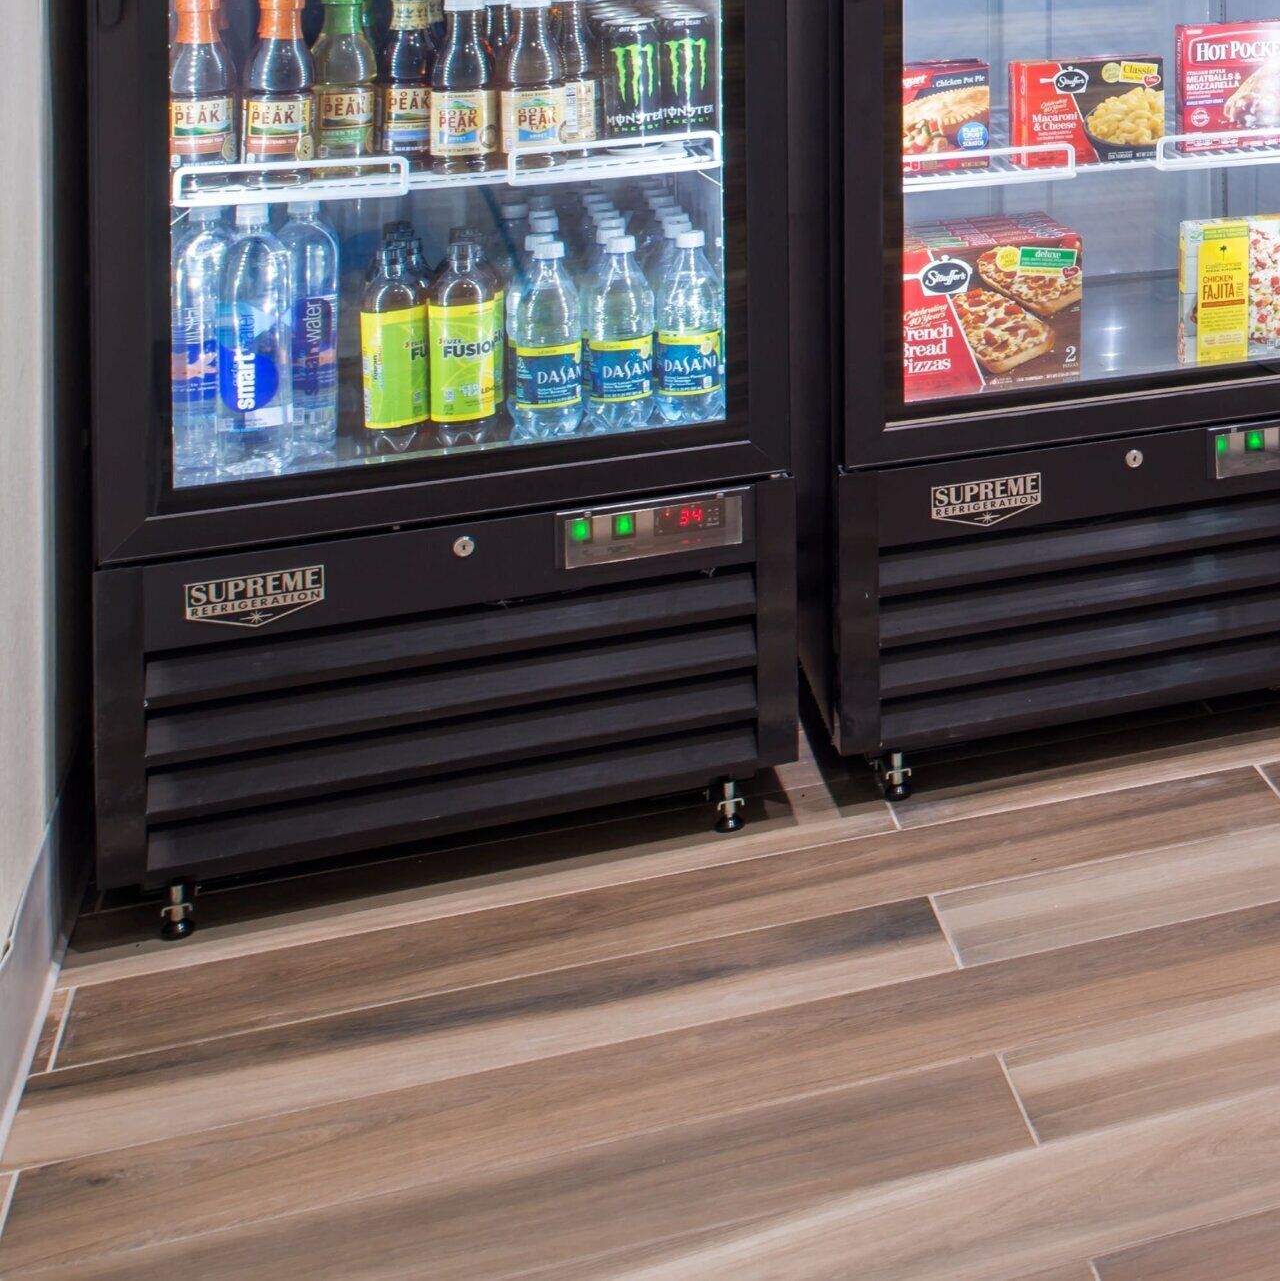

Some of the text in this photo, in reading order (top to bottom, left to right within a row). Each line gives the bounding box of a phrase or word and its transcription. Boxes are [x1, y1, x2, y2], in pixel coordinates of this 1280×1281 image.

[1196, 42, 1228, 62] HOT
[1123, 64, 1155, 75] Classic
[936, 79, 962, 88] Chicken
[1186, 73, 1233, 83] MEATBALLS
[1186, 80, 1239, 91] MOZZARELLA
[174, 103, 220, 111] GOLD
[324, 102, 365, 116] PEAK
[388, 96, 431, 110] PEAK
[174, 110, 220, 124] PEAK
[252, 110, 294, 124] PEAK
[518, 106, 556, 115] GOLD
[1032, 111, 1077, 122] Macaroni
[439, 115, 478, 128] PEAK
[518, 114, 557, 127] PEAK
[1033, 121, 1077, 131] & Cheese
[1035, 249, 1061, 259] deluxe
[925, 269, 966, 286] Stouffer's
[1202, 274, 1233, 284] CHICKEN
[1203, 283, 1235, 300] FAJITA
[904, 304, 948, 321] Celebrating
[303, 301, 323, 343] water
[1065, 346, 1077, 363] 2
[665, 355, 716, 374] DASANI
[236, 349, 256, 410] smart
[935, 476, 1038, 506] SUPREME
[935, 495, 1038, 517] REFRIGERATION
[190, 569, 321, 606] SUPREME
[190, 590, 321, 617] REFRIGERATION
